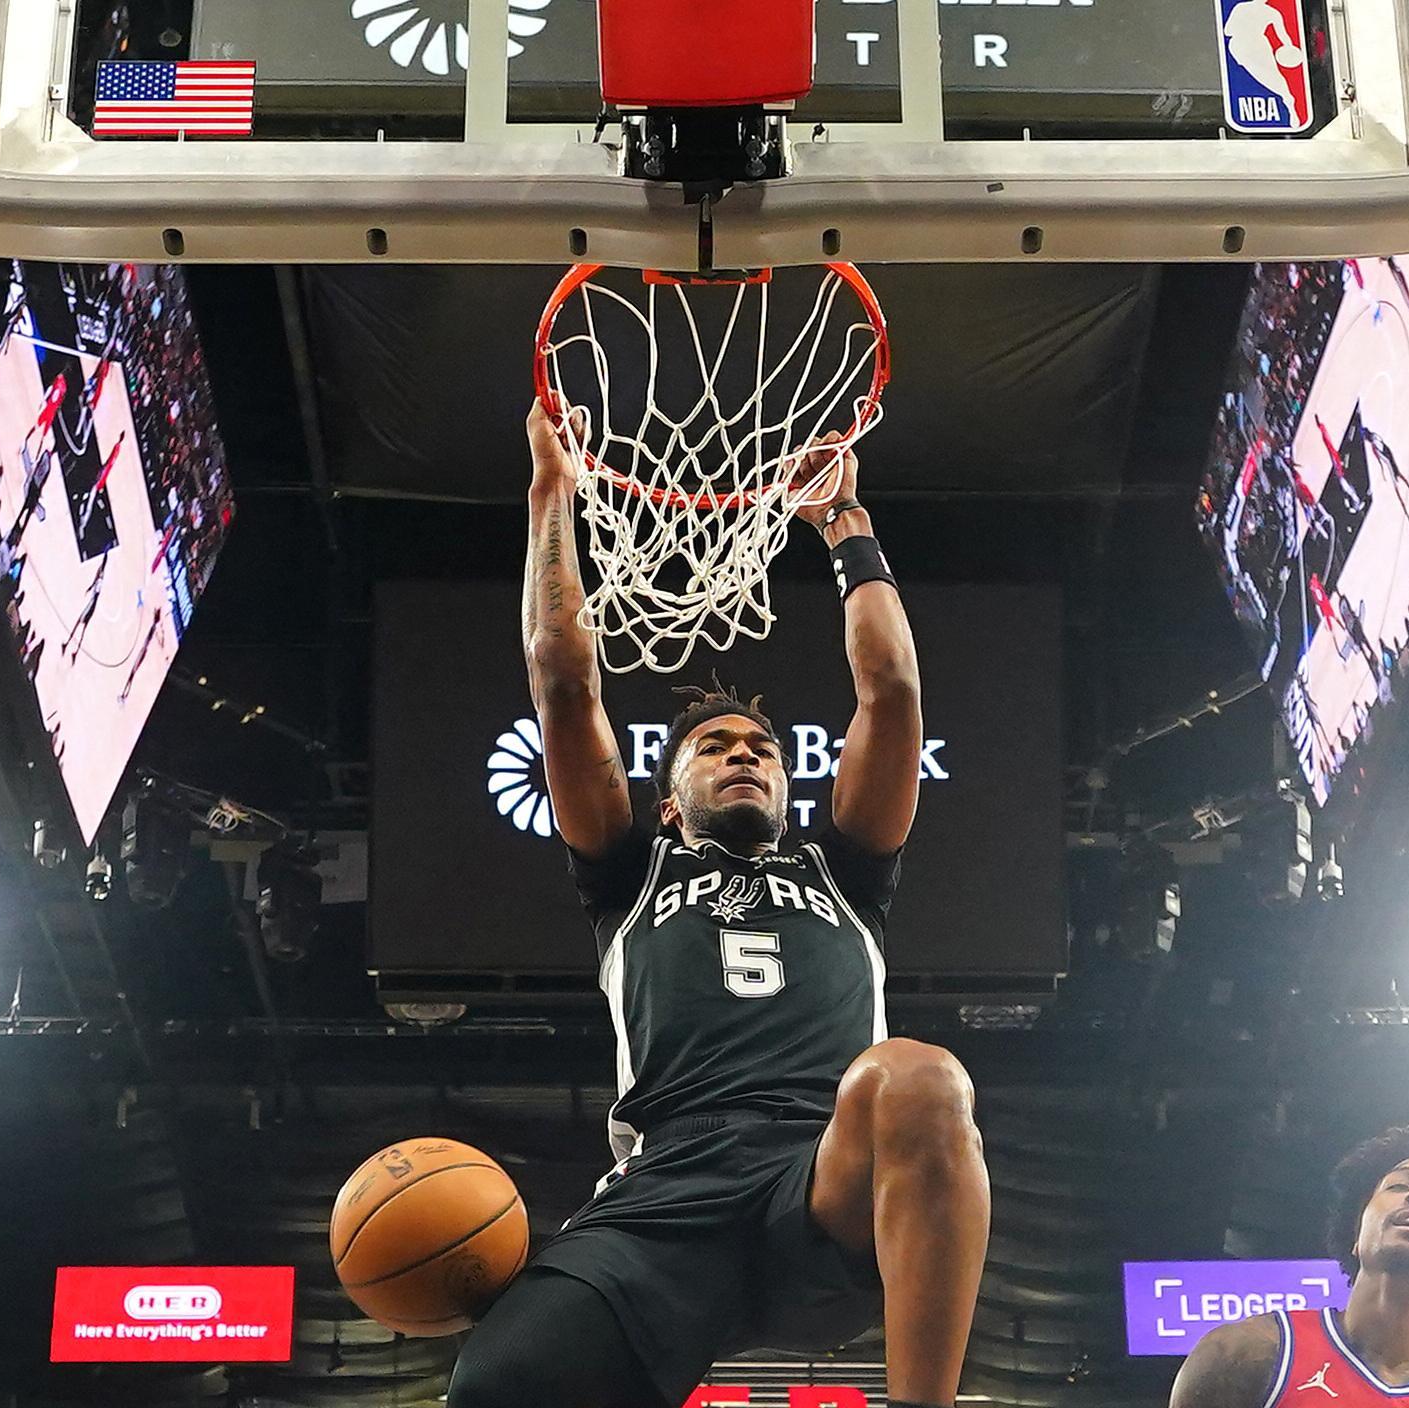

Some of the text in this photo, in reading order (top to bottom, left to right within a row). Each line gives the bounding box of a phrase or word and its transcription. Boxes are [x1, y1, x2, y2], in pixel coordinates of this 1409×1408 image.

[1238, 97, 1281, 122] NBA
[653, 870, 840, 928] SPURS
[718, 929, 787, 998] 5
[1180, 1293, 1308, 1321] LEDGER
[75, 1323, 268, 1341] Here Everything's Better
